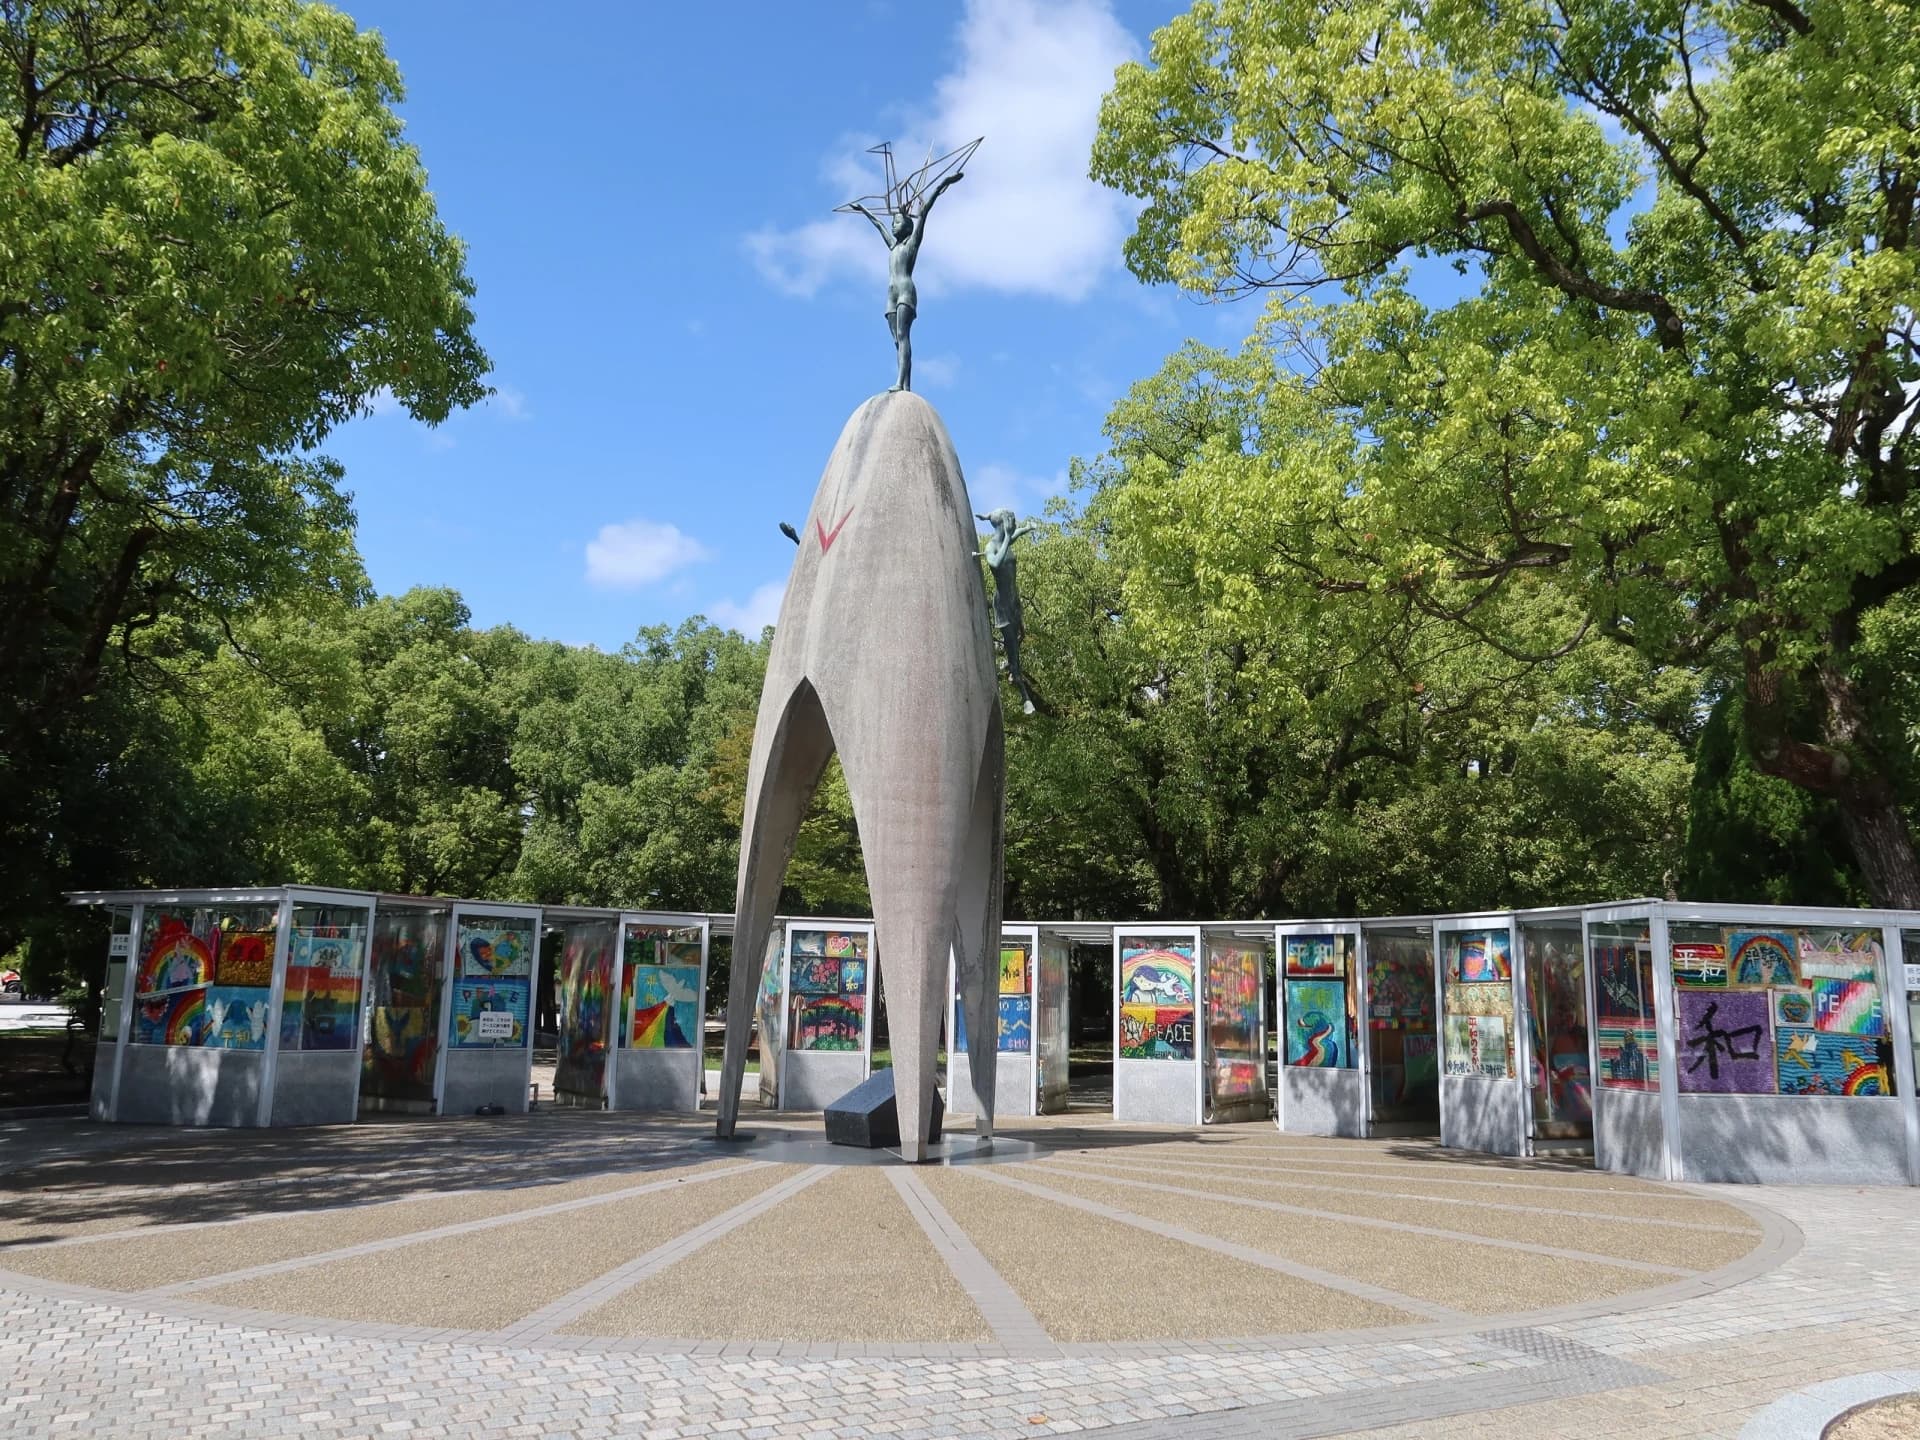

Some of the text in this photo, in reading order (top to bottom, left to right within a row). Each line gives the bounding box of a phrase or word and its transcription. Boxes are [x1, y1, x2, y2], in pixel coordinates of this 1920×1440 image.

[1674, 948, 1721, 982] 平和
[462, 984, 520, 1003] PEACE
[1148, 1023, 1192, 1042] PEACE
[1686, 1001, 1763, 1079] 和
